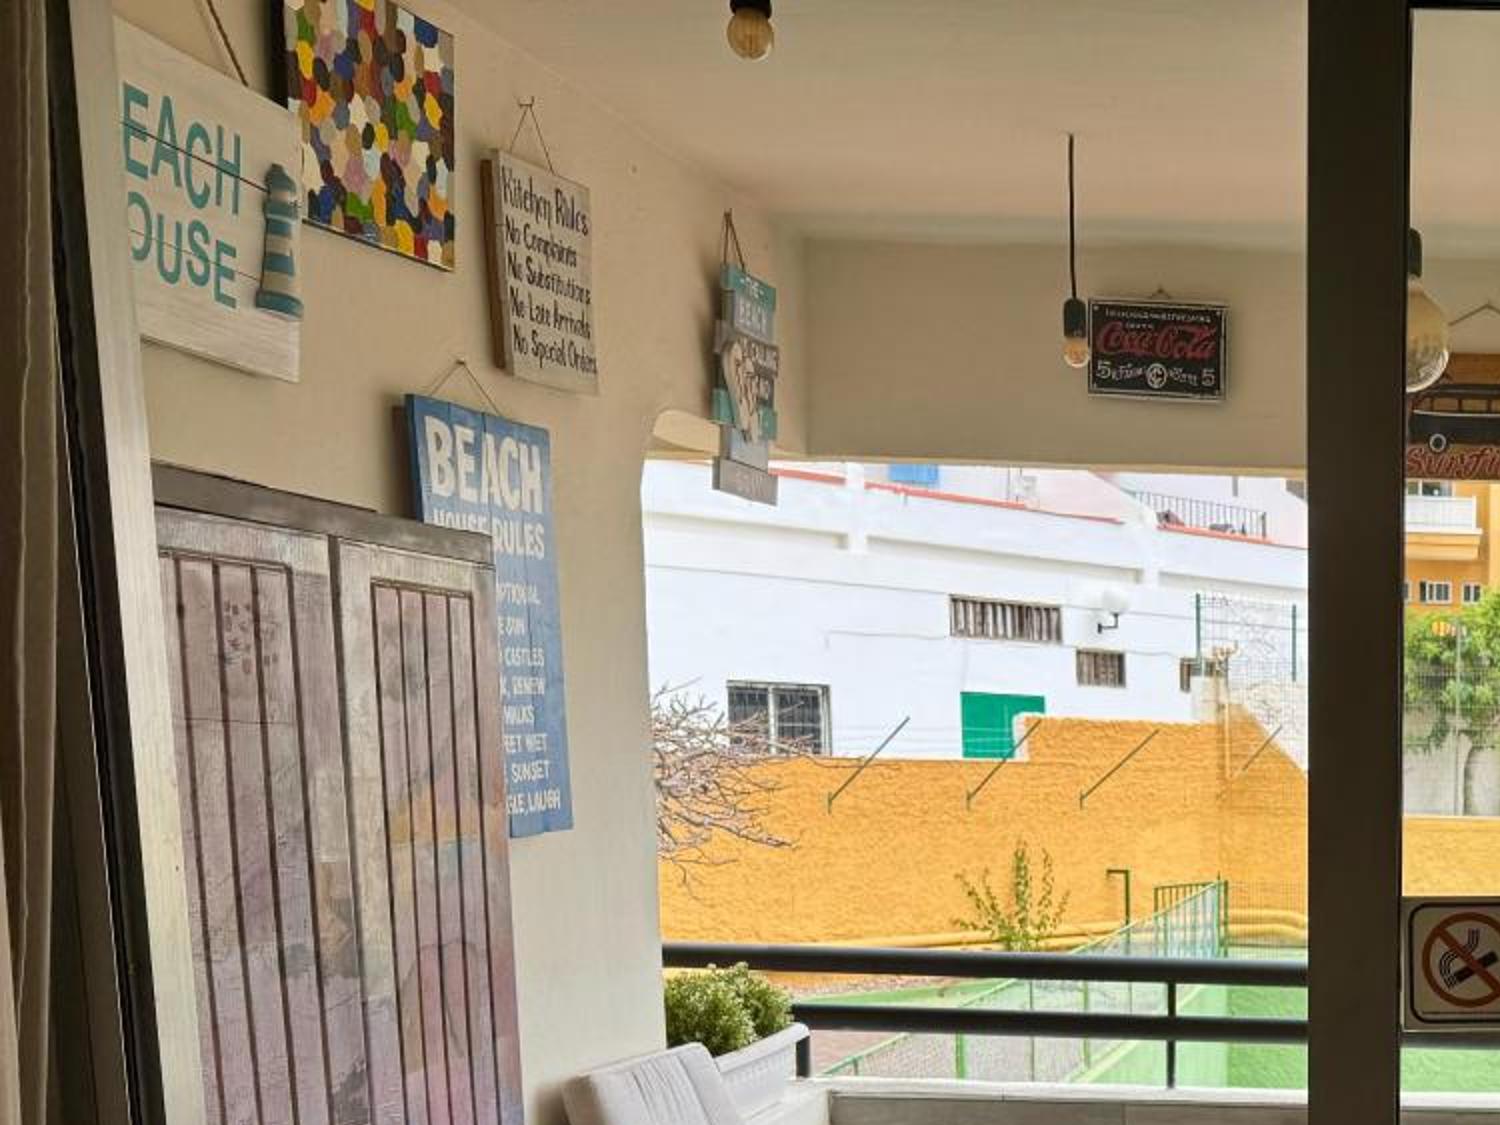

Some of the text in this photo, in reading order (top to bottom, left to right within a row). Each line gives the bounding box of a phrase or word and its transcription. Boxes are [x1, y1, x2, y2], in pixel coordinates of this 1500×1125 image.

[122, 81, 241, 216] EACH
[502, 165, 589, 236] Kitchen Rules
[127, 191, 237, 309] OUSE
[505, 213, 577, 268] No Complaints
[507, 249, 591, 305] No Substitutions
[510, 285, 525, 319] No
[527, 290, 550, 327] Late
[513, 322, 529, 356] No
[531, 329, 567, 369] Special
[1096, 320, 1218, 362] Coca-Cola
[424, 415, 543, 515] BEACH
[492, 517, 545, 560] RULES
[497, 582, 542, 606] PTIONAL
[504, 646, 545, 667] CASTLES
[511, 759, 549, 783] SUNSET
